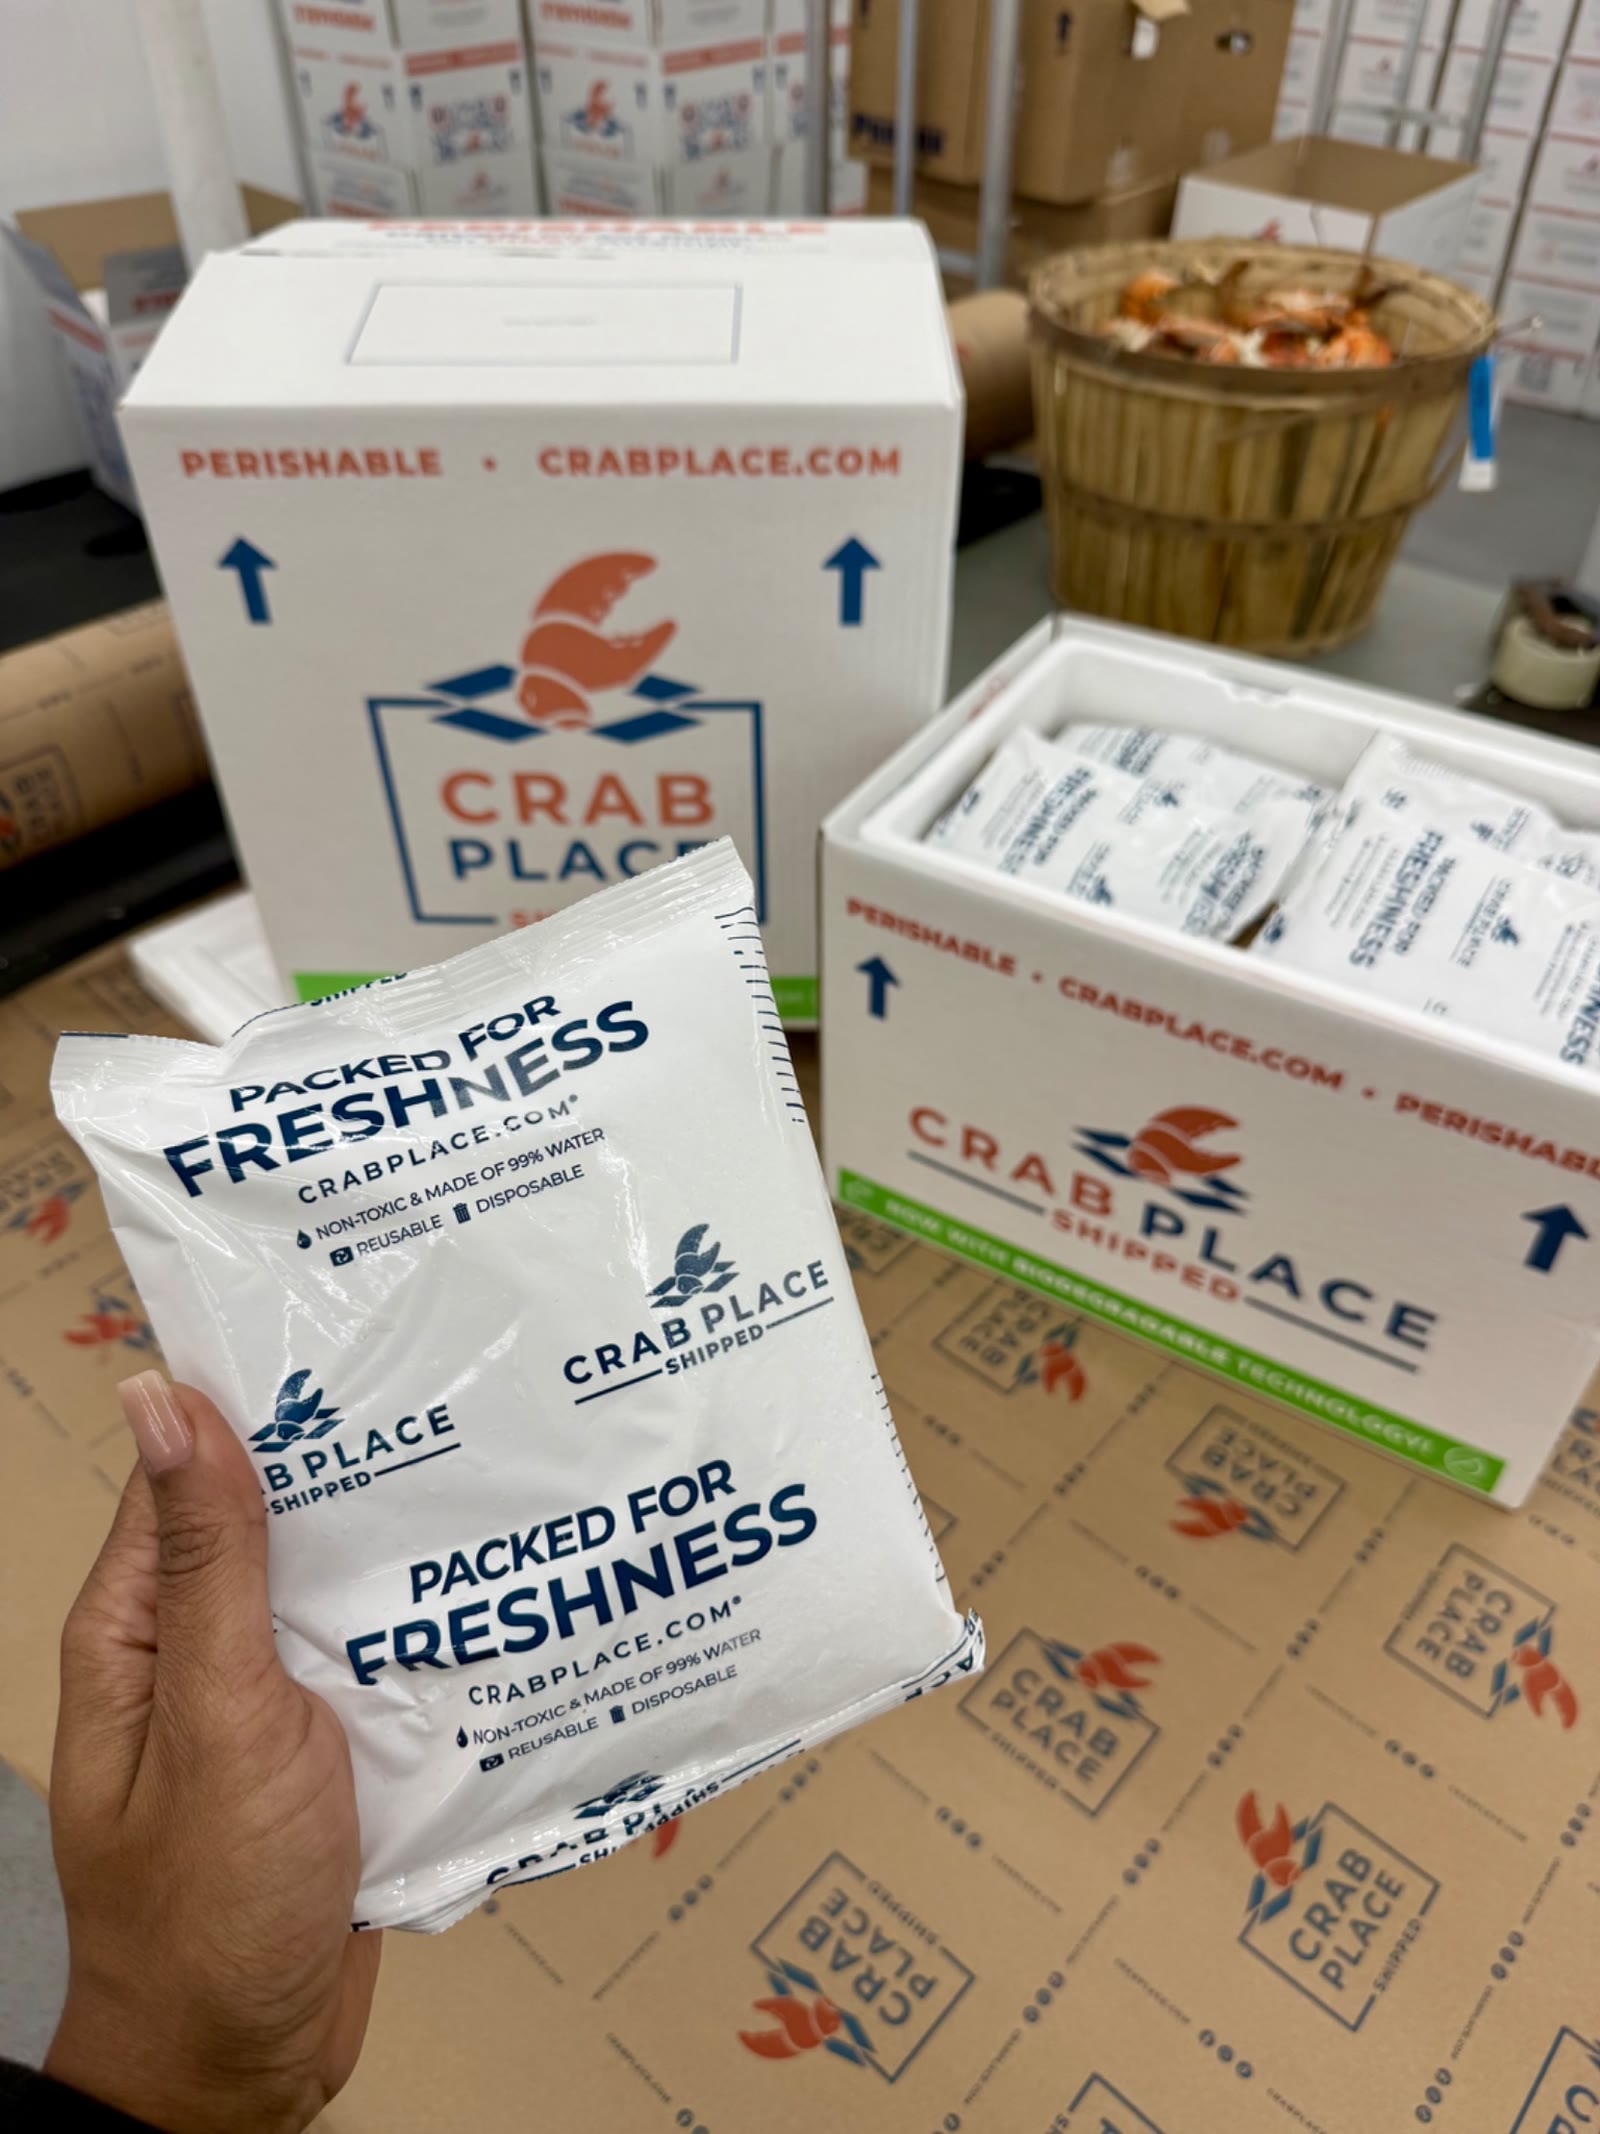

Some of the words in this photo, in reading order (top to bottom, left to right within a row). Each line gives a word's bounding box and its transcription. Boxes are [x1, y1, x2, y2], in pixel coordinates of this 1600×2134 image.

[181, 449, 443, 478] PERISHABLE
[539, 447, 901, 477] CRABPLACE.COM
[441, 770, 715, 827] CRAB
[848, 899, 1017, 978] PERISHABLE
[1059, 976, 1344, 1092] CRABPLACE.COM
[163, 1001, 649, 1198] FRESHNESS
[229, 1049, 451, 1112] PACKED
[459, 995, 561, 1061] FOR
[316, 1197, 408, 1240] NON-TOXIC
[409, 1192, 424, 1207] &
[425, 1173, 479, 1201] MADE
[480, 1162, 506, 1182] OF
[508, 1149, 544, 1172] 99%
[544, 1128, 605, 1158] WATER
[356, 1214, 443, 1256] REUSABLE
[476, 1163, 584, 1214] DISPOSABLE
[908, 1105, 1112, 1220] CRAB
[1141, 1201, 1439, 1354] PLACE
[1051, 1210, 1241, 1303] SHIPPED
[563, 1317, 691, 1384] CRAB
[700, 1260, 829, 1333] PLACE
[665, 1324, 764, 1375] SHIPPED
[270, 1471, 372, 1514] SHIPPED
[302, 1403, 455, 1479] PLACE
[345, 1482, 819, 1686] FRESHNESS
[409, 1505, 616, 1604] PACKED
[627, 1460, 737, 1534] FOR
[472, 1704, 567, 1745] NON-TOXIC
[569, 1698, 583, 1710] &
[583, 1677, 637, 1704] MADE
[639, 1666, 664, 1685] OF
[666, 1653, 702, 1674] 99%
[702, 1628, 762, 1661] WATER
[508, 1717, 600, 1759] REUSABLE
[631, 1664, 738, 1715] DISPOSABLE
[992, 1689, 1100, 1782] PLACE
[1012, 1668, 1118, 1757] CRAB
[821, 1887, 938, 1998] PLACE
[1289, 1849, 1373, 1961] CRAB
[1320, 1869, 1405, 1990] PLACE
[798, 1915, 911, 2025] CRAB
